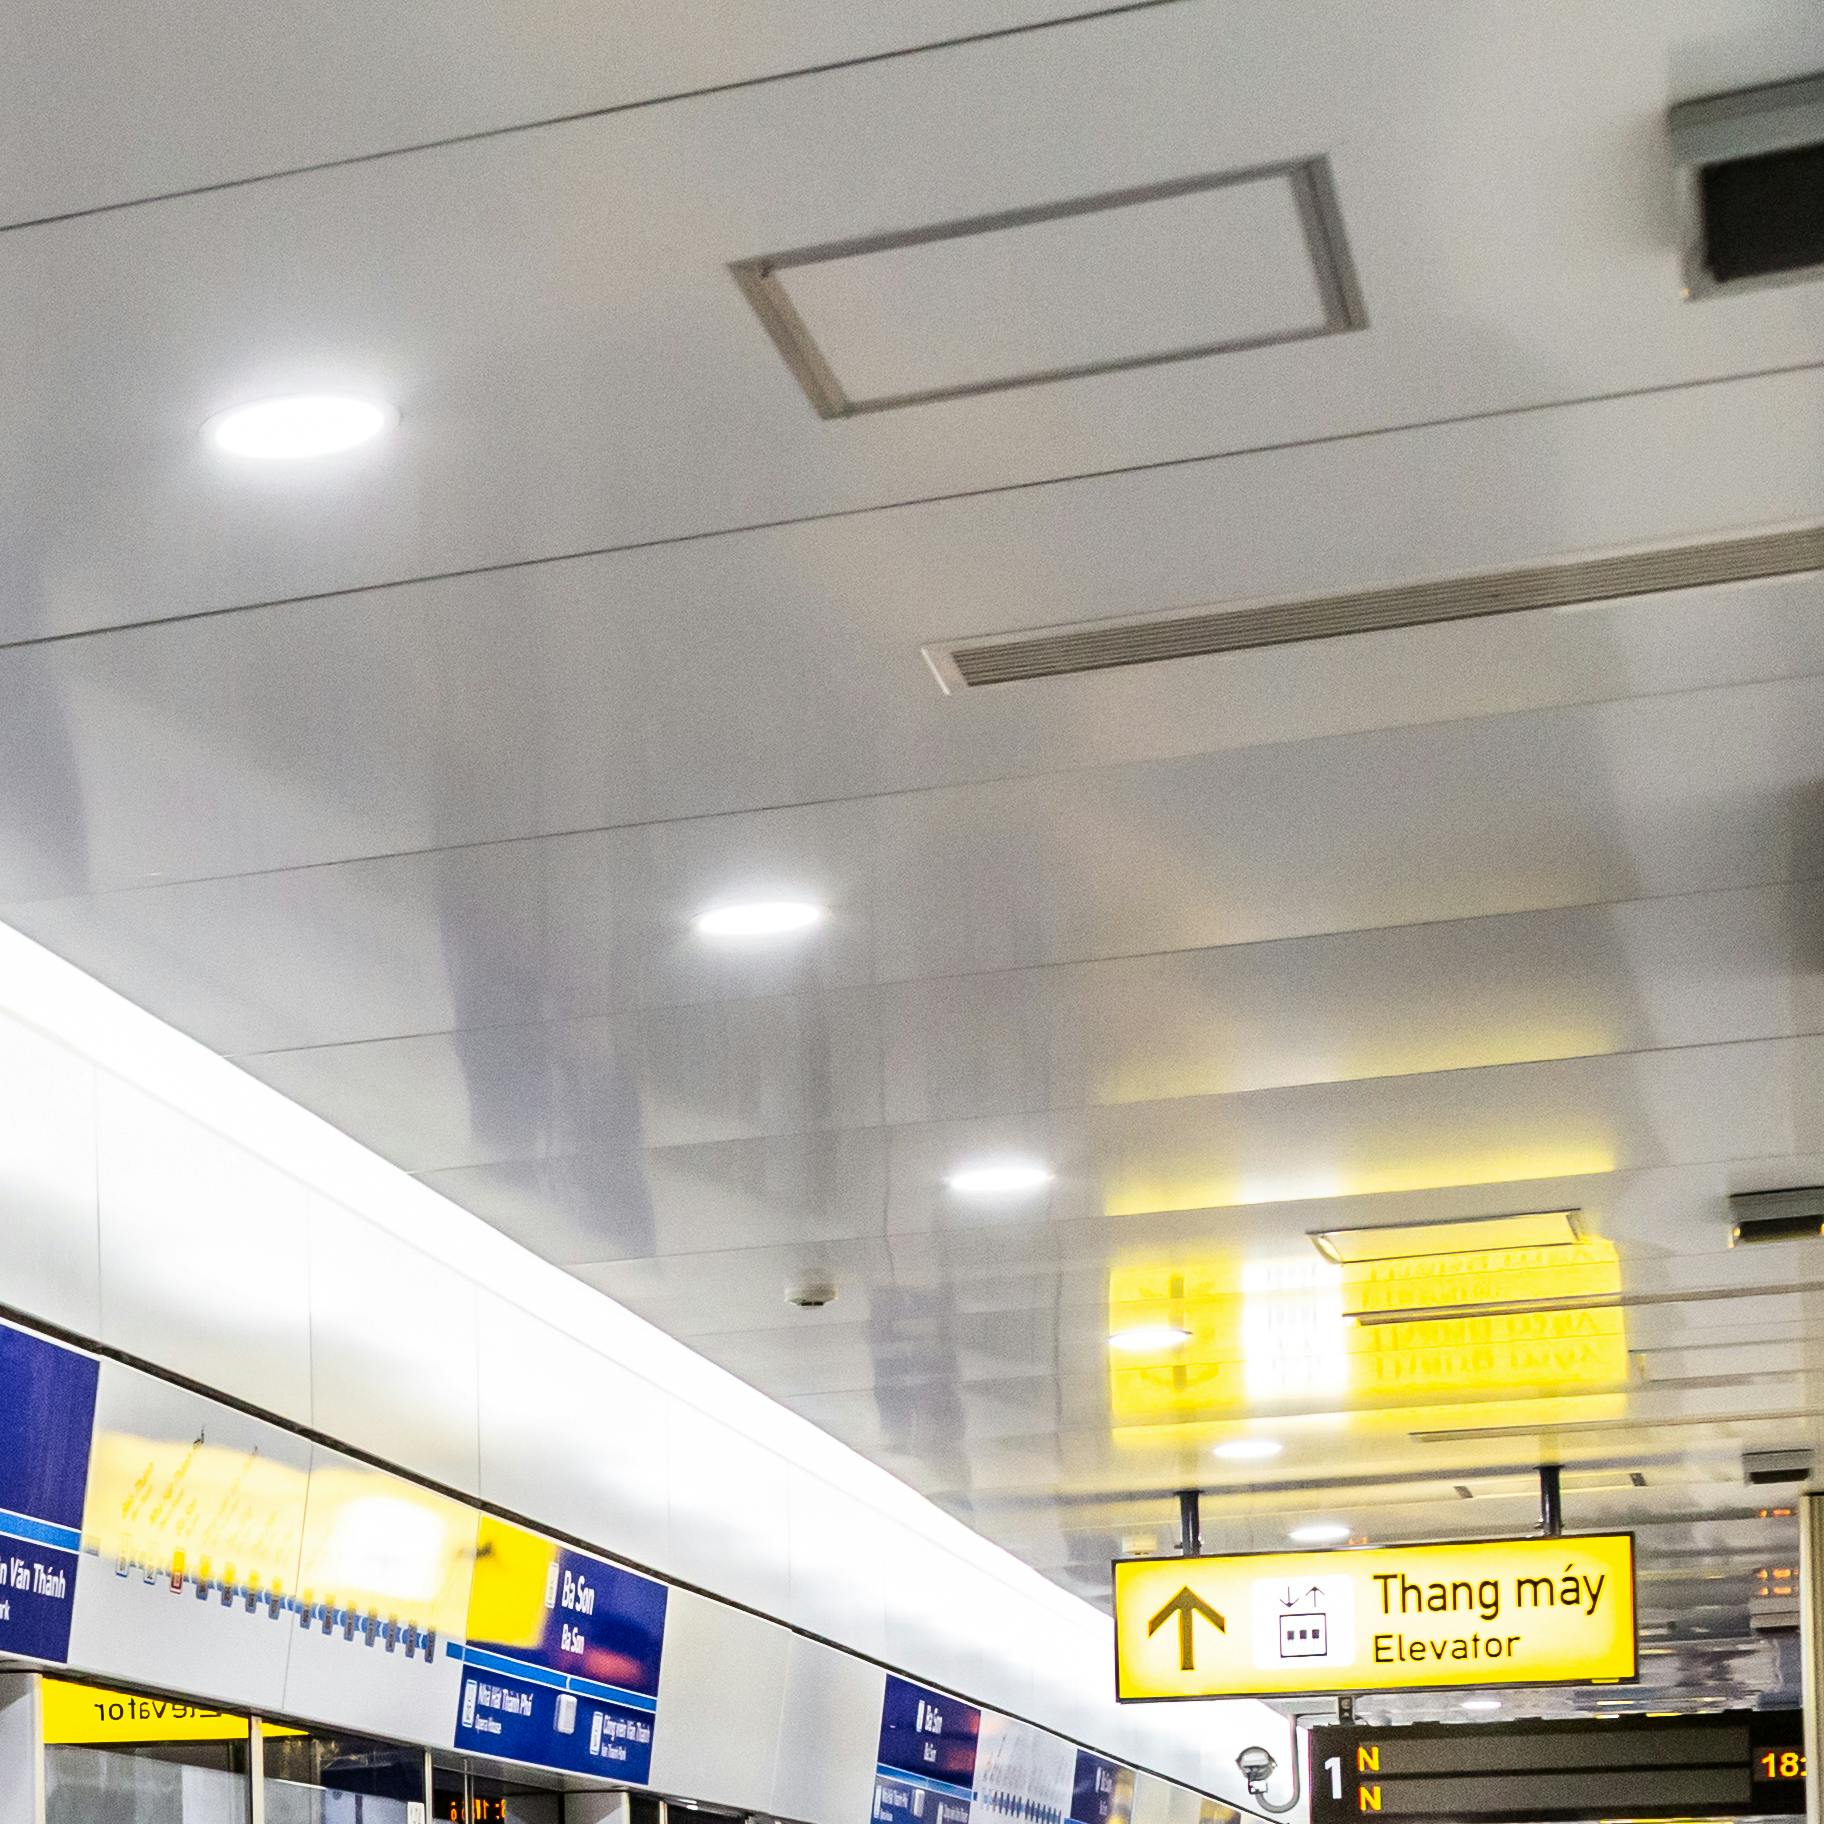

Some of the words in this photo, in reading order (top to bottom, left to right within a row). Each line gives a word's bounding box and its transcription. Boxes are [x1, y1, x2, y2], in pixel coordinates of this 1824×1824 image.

[33, 1563, 66, 1599] Thánh
[1373, 1573, 1499, 1620] Thang
[1517, 1563, 1606, 1616] máy
[1374, 1632, 1521, 1663] Elevator
[1325, 1756, 1342, 1799] 1
